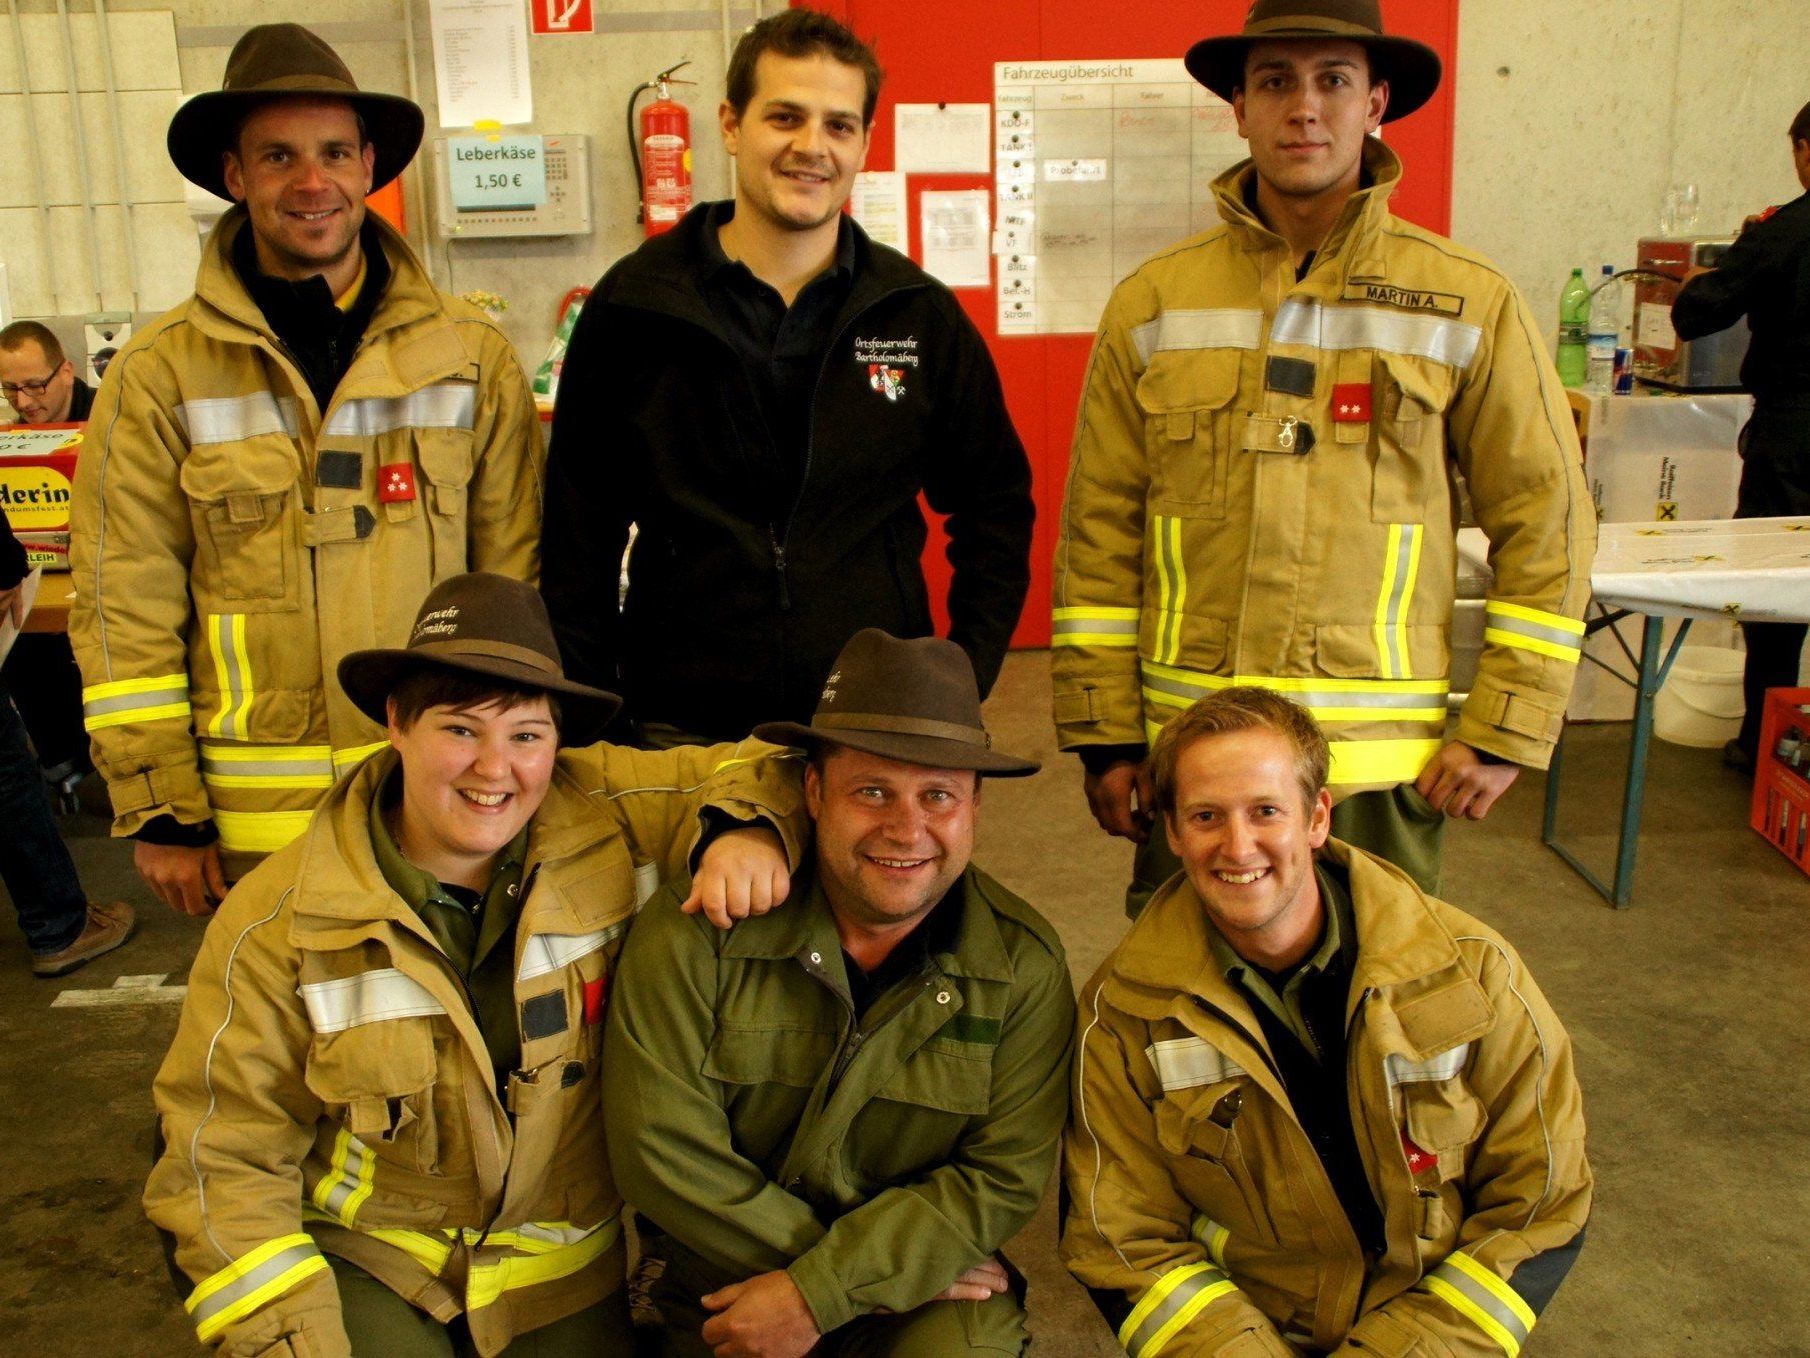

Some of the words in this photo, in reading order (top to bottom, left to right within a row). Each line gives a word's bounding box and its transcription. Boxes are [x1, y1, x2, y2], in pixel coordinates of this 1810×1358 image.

[1003, 64, 1133, 81] Fahrzeugübersicht
[456, 146, 536, 161] Leberkäse
[475, 174, 507, 190] 1,50
[512, 173, 522, 187] €
[1366, 286, 1421, 307] MARTIN
[1423, 294, 1438, 308] A.
[855, 335, 918, 352] Ortsfeuerwehr
[855, 351, 919, 367] Bartholomäberg
